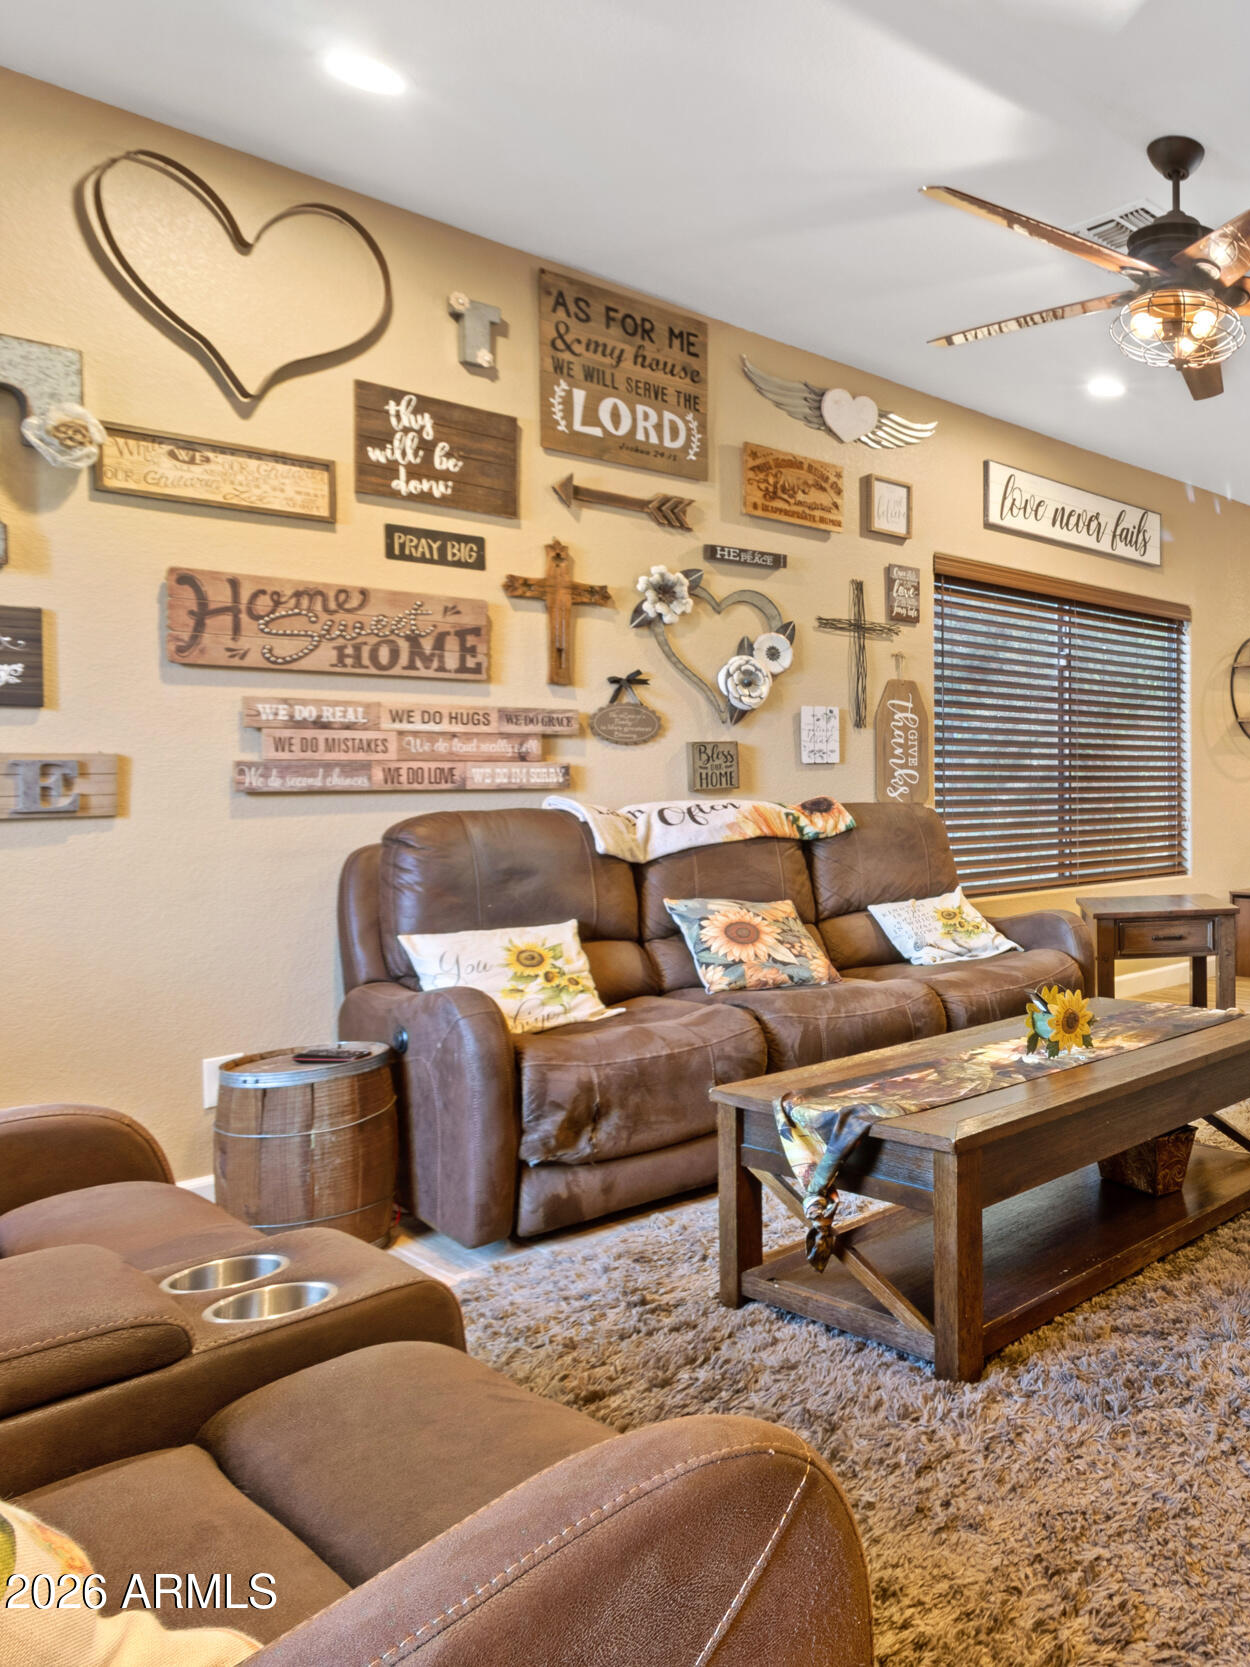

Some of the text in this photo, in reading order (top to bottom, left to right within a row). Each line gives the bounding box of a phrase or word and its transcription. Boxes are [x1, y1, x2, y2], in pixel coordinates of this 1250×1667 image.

[551, 290, 700, 358] AS FOR ME
[551, 320, 702, 384] & my house
[551, 355, 700, 412] WE WILL SERVE THE
[384, 394, 434, 441] thy
[572, 387, 687, 449] LORD
[367, 432, 464, 472] will be
[1000, 474, 1151, 557] love never fails
[393, 532, 478, 563] PRAY BIG
[715, 546, 740, 560] HE
[740, 554, 774, 566] PEACE
[175, 572, 370, 656] Home
[257, 600, 437, 665] Sweet
[330, 626, 483, 675] HOME
[256, 704, 368, 723] WE DO REAL
[389, 709, 491, 726] WE DO HUGS
[505, 714, 573, 728] WE DO GRACE
[273, 736, 389, 754] WE DO MISTAKES
[403, 737, 430, 753] We
[698, 744, 735, 765] Bless
[887, 693, 920, 802] thanks
[908, 730, 918, 766] GIVE
[286, 768, 323, 787] second
[382, 767, 457, 785] WE DO LOVE
[471, 768, 492, 784] WE
[495, 768, 509, 784] DO
[530, 768, 565, 785] SORRY
[699, 772, 735, 788] HOME
